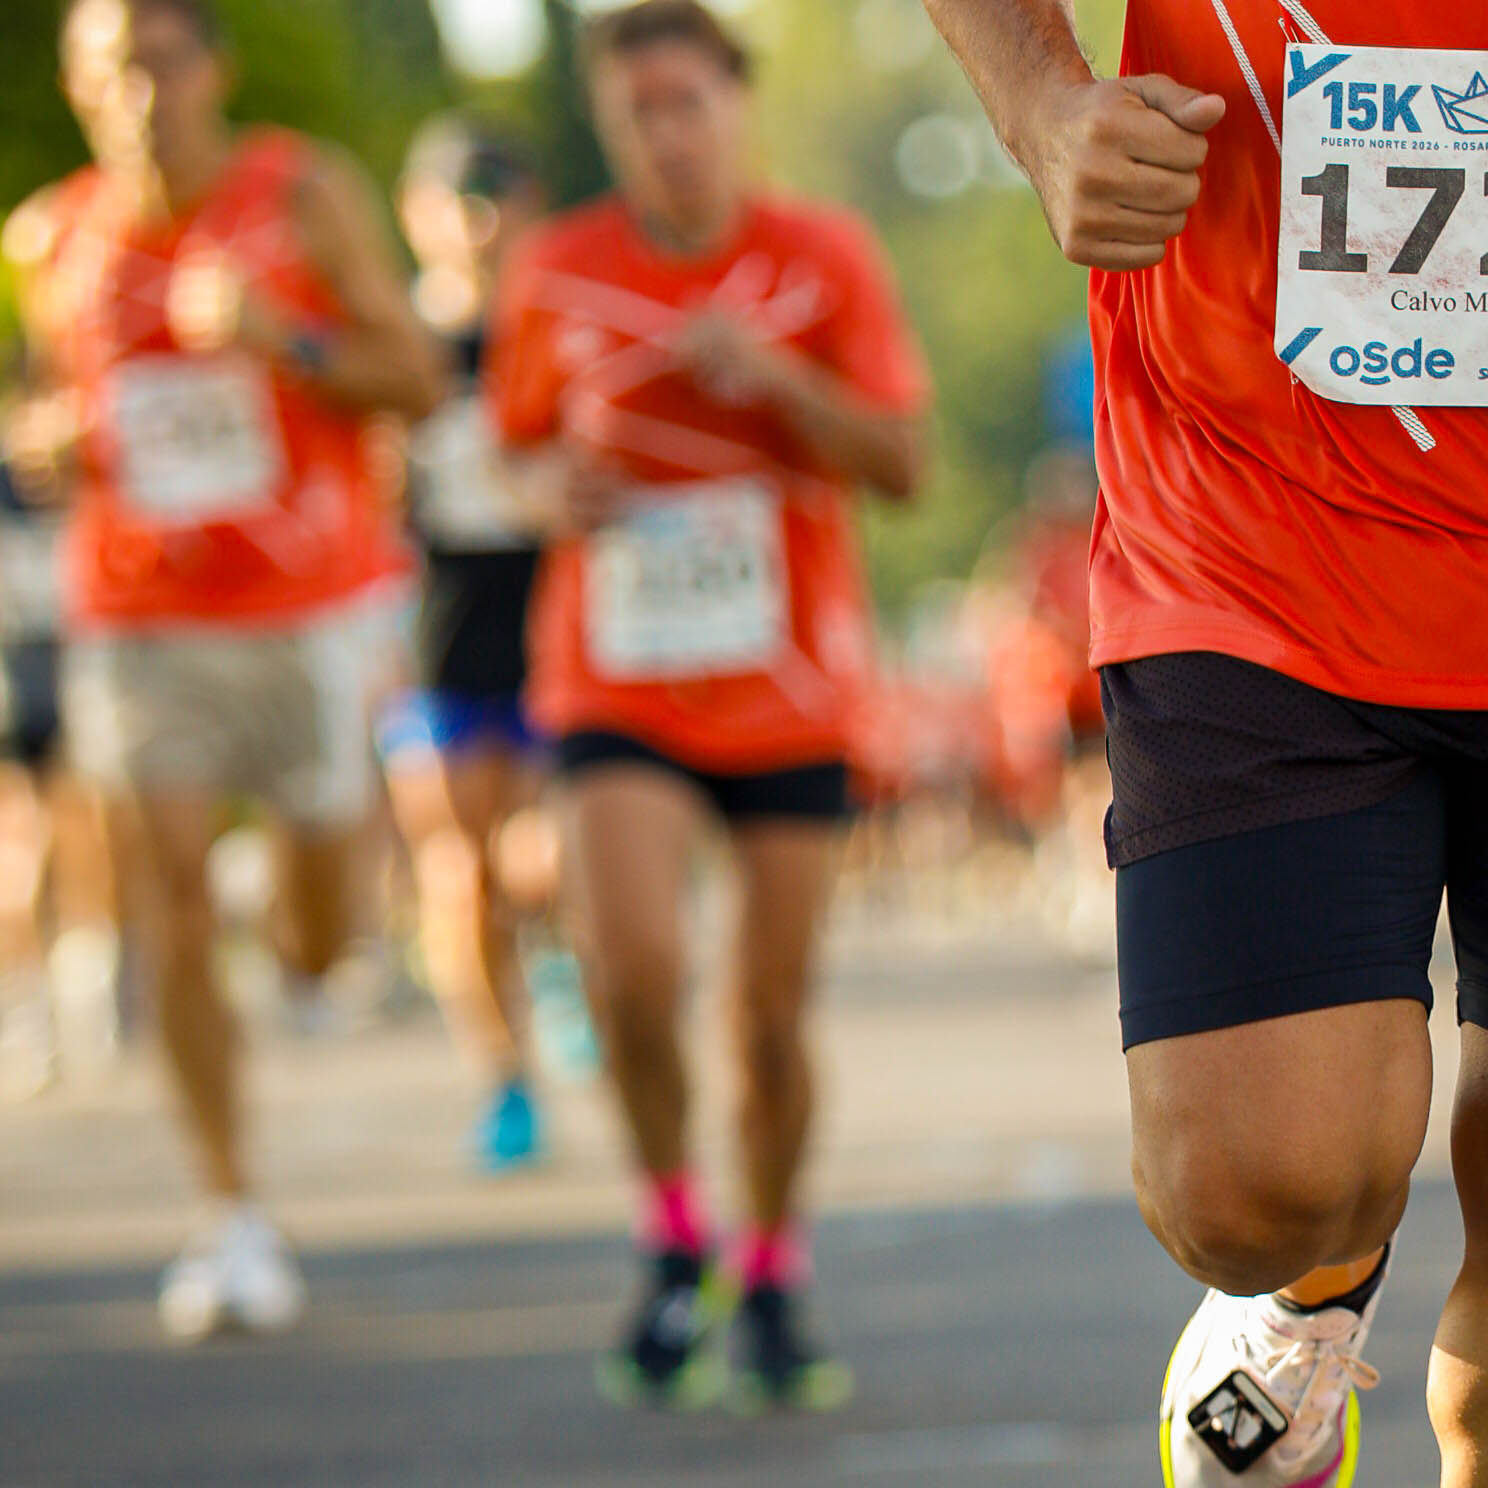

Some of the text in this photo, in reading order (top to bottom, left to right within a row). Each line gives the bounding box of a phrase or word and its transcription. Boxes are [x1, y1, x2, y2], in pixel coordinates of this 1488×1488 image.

[1322, 81, 1424, 134] 15K
[1320, 137, 1366, 148] PUERTO
[1369, 139, 1407, 149] NORTE
[1412, 140, 1440, 151] 2026
[1390, 289, 1457, 312] Calvo
[1329, 336, 1456, 383] osde
